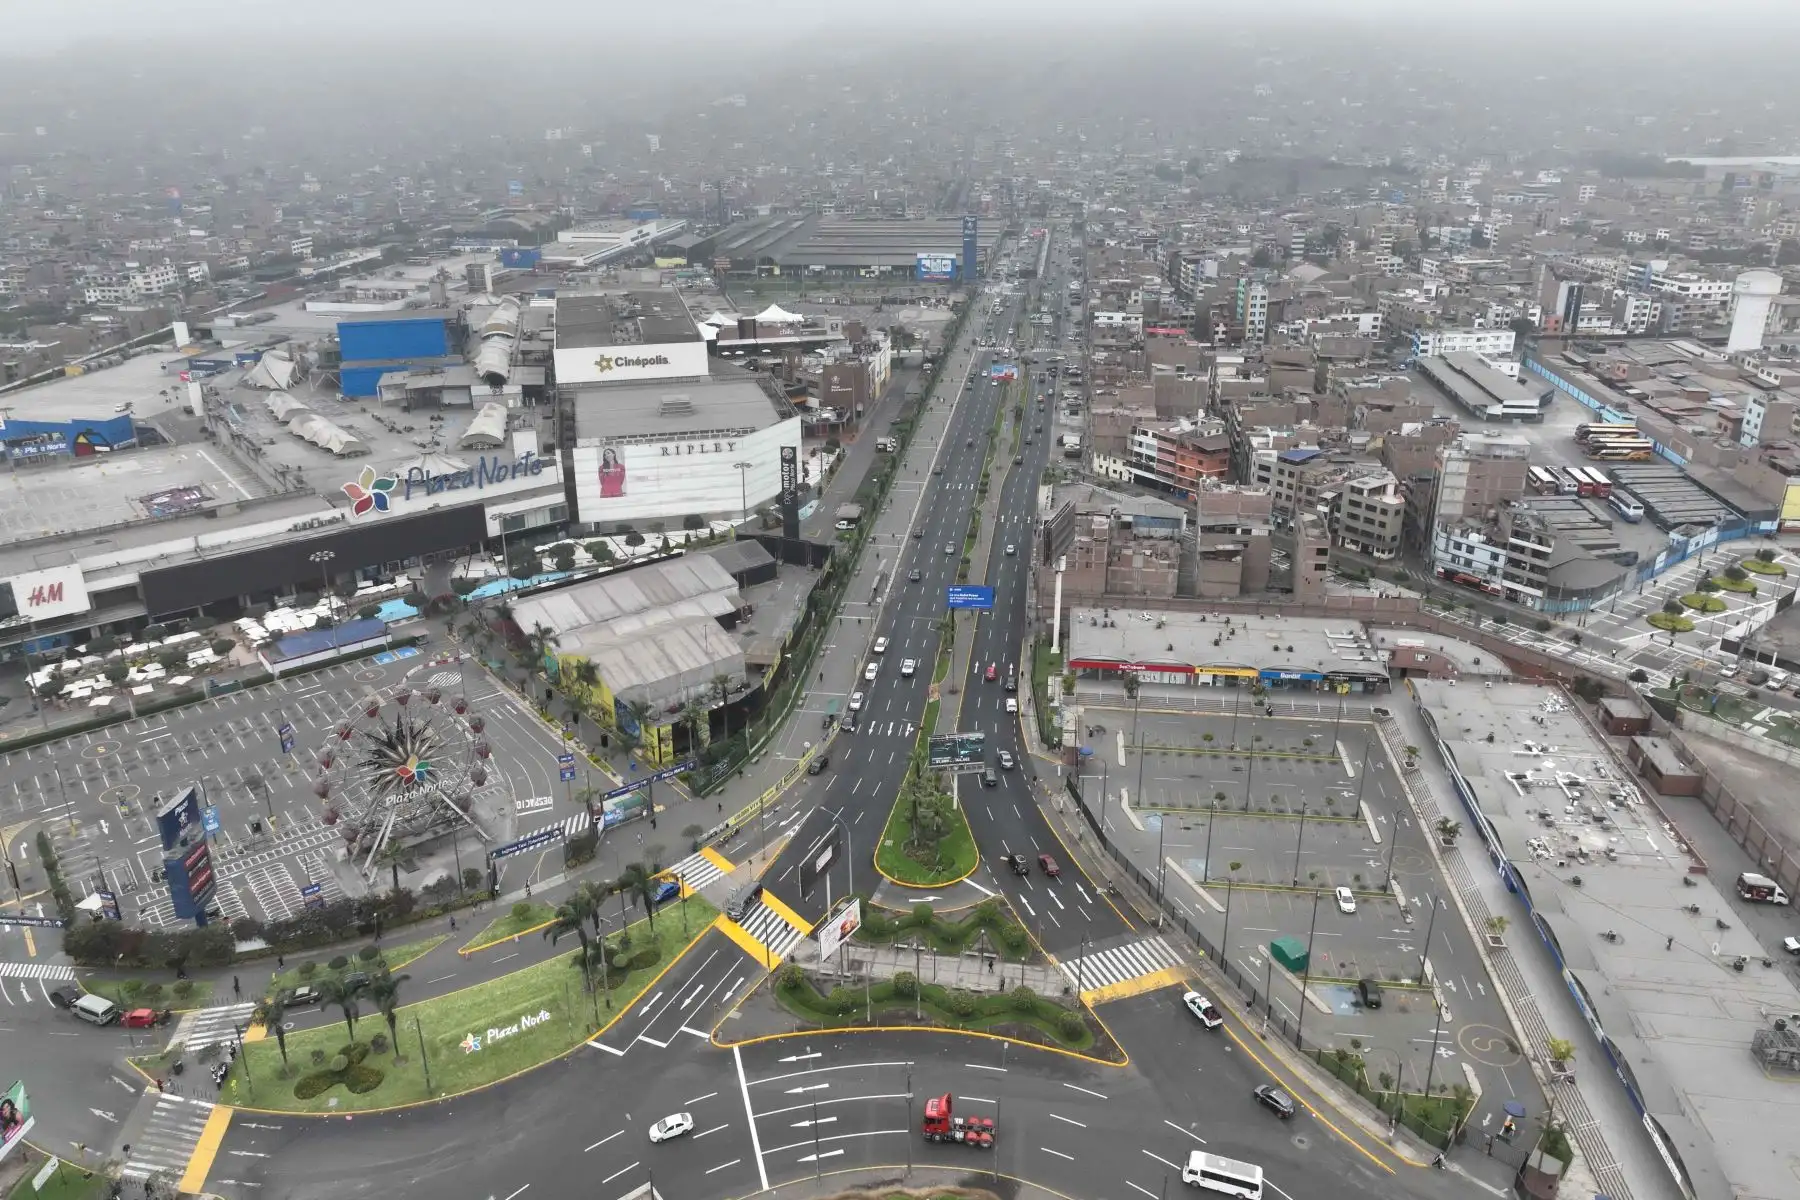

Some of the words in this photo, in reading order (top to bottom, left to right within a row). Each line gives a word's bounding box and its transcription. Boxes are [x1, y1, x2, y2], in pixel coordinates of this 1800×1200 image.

[614, 355, 669, 368] Cinépolis
[659, 441, 736, 456] RIPLEY
[404, 466, 475, 501] Plaza
[477, 450, 543, 490] Norte
[27, 581, 63, 607] H&M
[385, 790, 418, 807] Plaza
[420, 779, 448, 795] Norte
[516, 796, 553, 810] DESPACIO
[487, 1024, 518, 1044] Plaza
[521, 1009, 551, 1031] Norte
